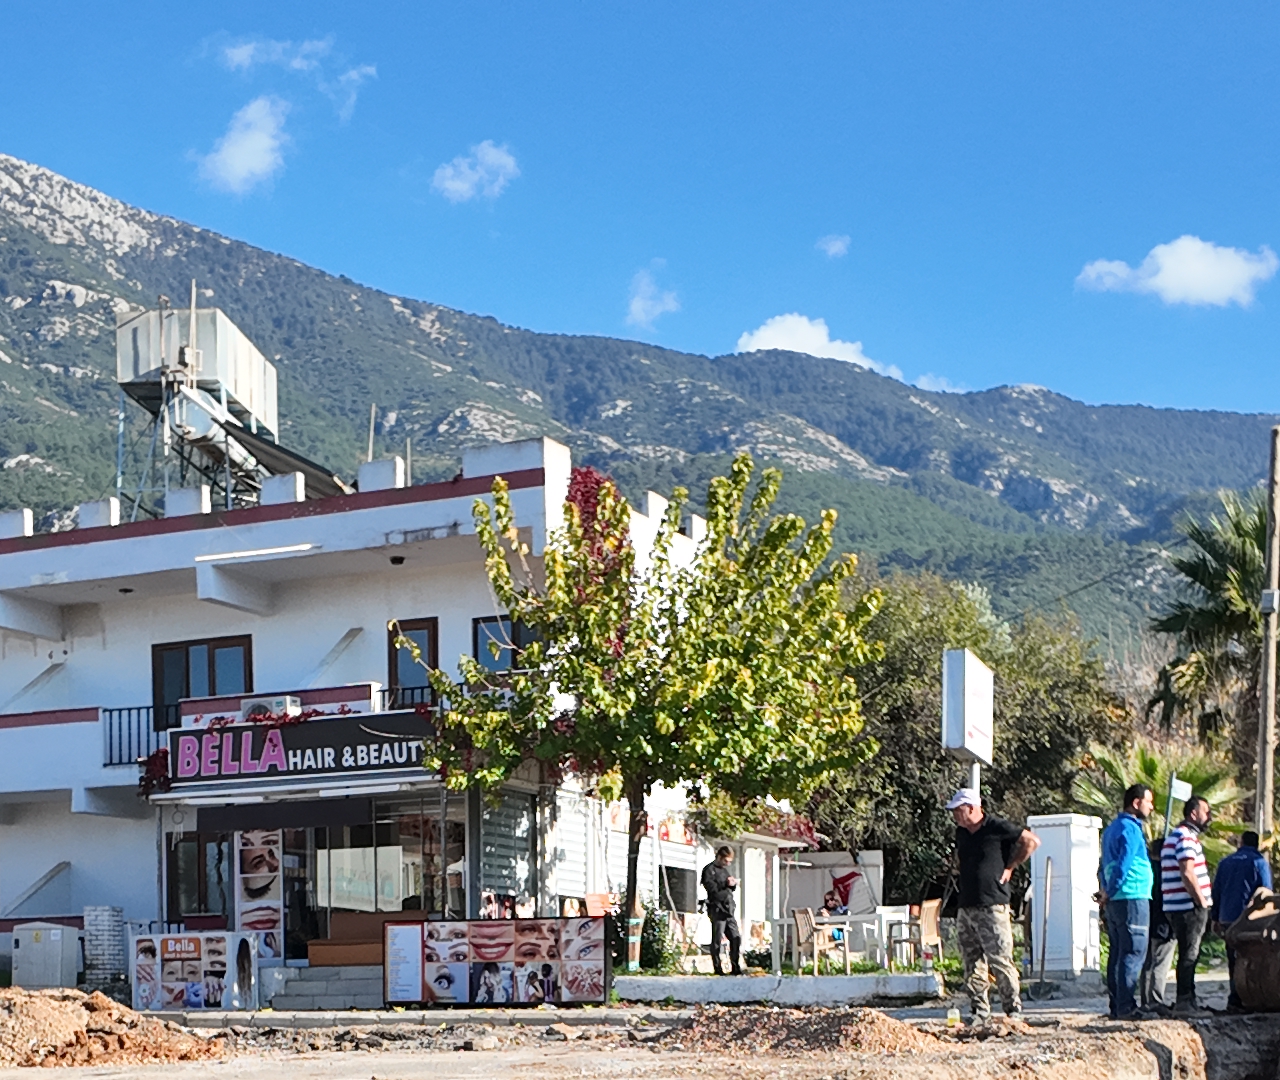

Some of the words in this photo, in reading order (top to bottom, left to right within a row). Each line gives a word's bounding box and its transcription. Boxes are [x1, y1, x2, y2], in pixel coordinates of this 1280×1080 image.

[177, 728, 287, 778] BELLA
[288, 747, 335, 771] HAIR
[167, 939, 195, 952] Bella
